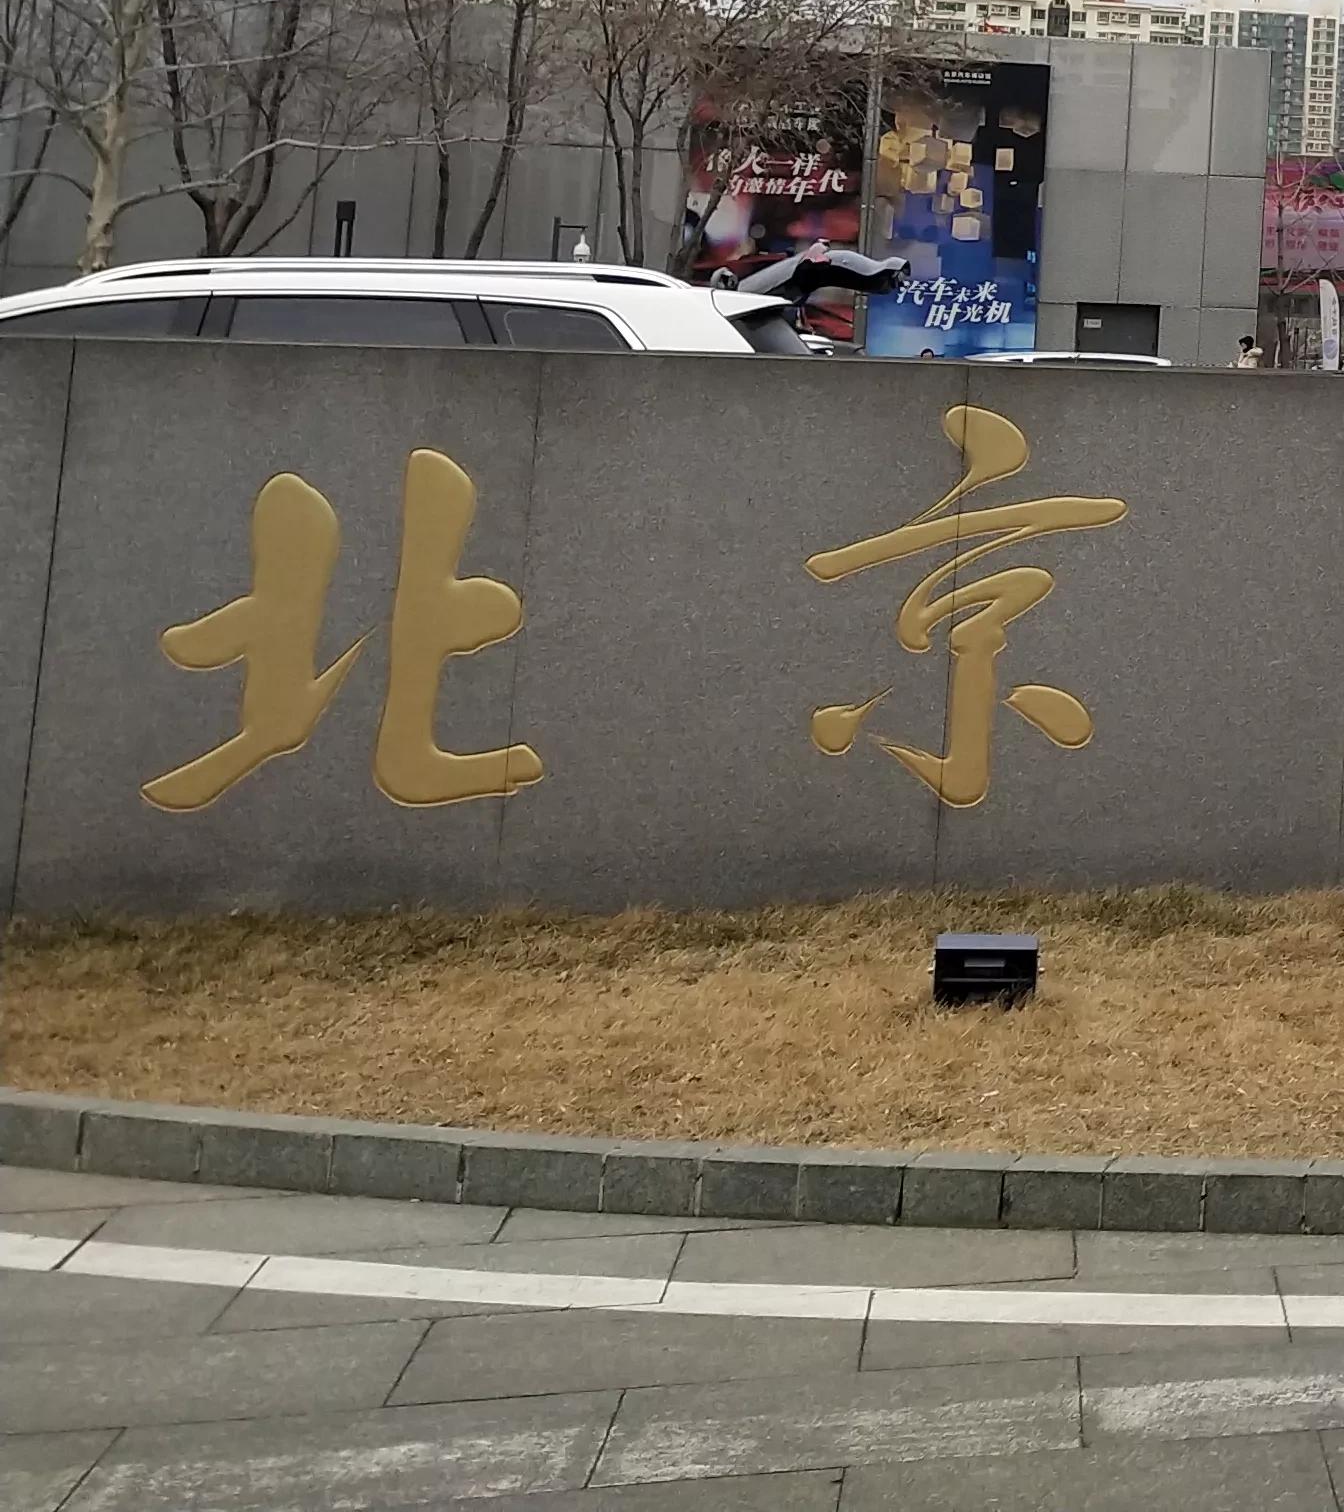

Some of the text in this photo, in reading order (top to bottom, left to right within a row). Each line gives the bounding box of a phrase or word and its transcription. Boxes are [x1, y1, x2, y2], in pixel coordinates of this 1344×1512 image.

[896, 276, 999, 306] 汽车未来
[924, 301, 1012, 331] 时光机
